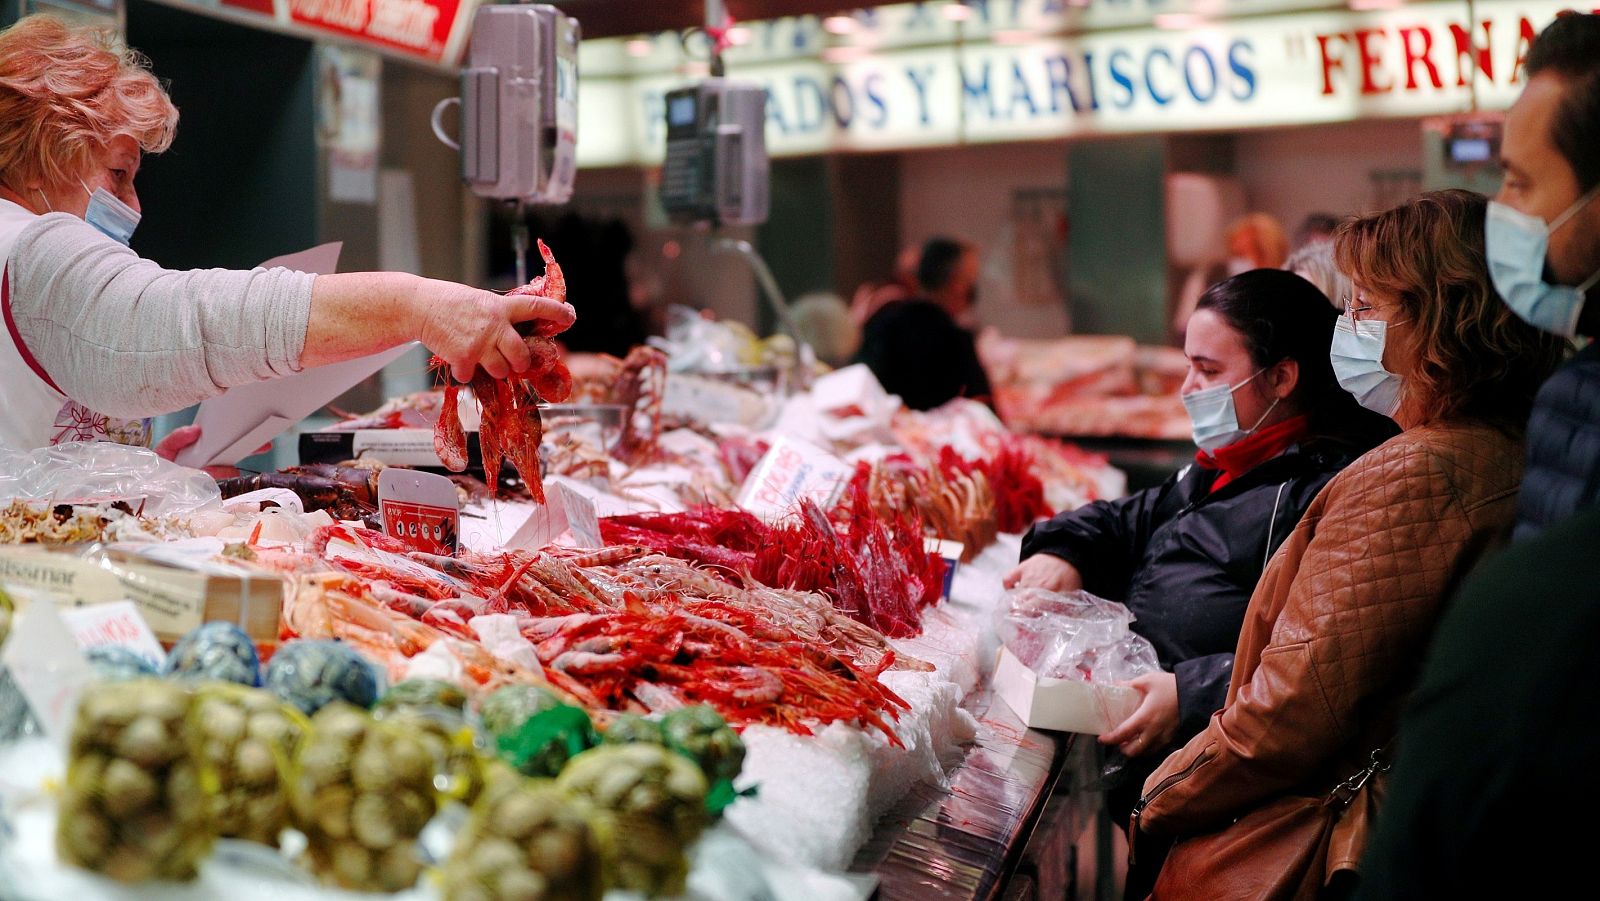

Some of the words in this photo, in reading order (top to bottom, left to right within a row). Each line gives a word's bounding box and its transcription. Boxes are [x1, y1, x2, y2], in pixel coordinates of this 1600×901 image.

[641, 70, 888, 146] PADOS
[907, 65, 936, 126] Y
[961, 37, 1258, 122] MARISCOS
